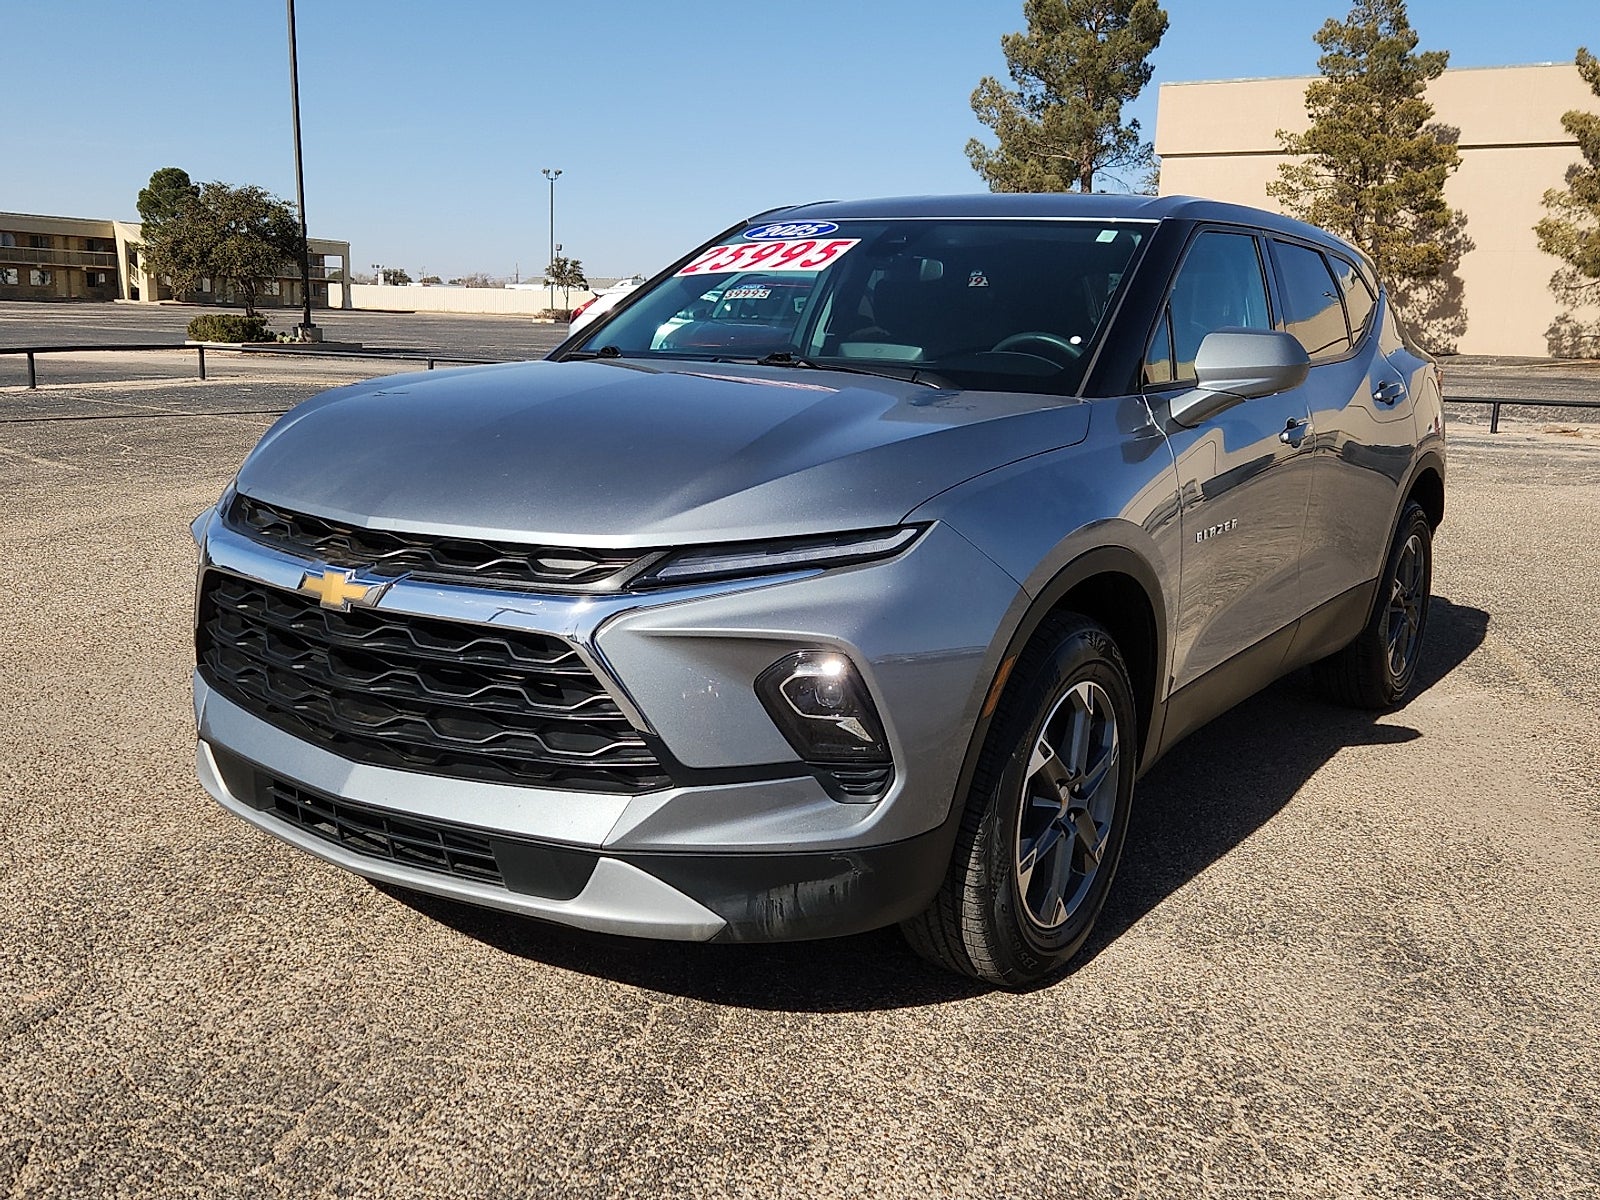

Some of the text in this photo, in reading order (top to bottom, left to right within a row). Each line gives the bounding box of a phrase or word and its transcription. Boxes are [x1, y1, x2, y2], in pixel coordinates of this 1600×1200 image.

[752, 224, 829, 238] 2025
[680, 241, 855, 274] 25995
[725, 289, 768, 299] 39995
[1196, 519, 1238, 543] BLAZER
